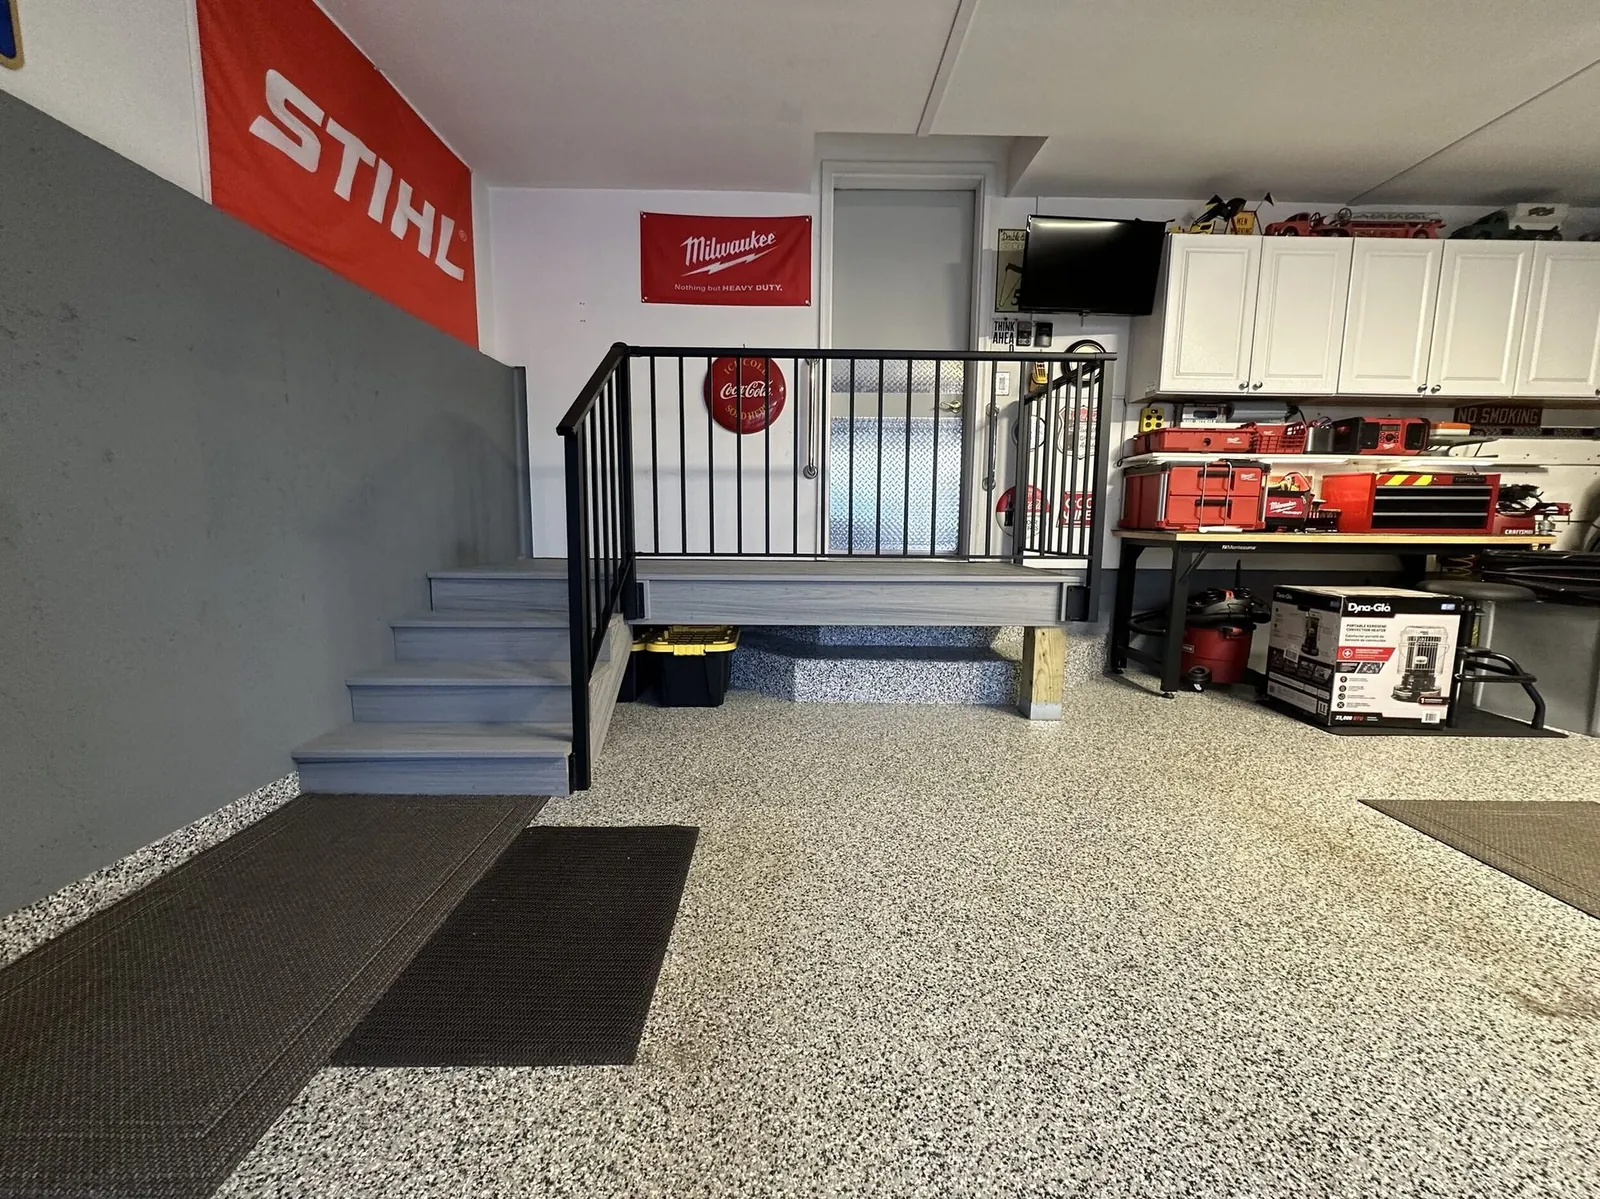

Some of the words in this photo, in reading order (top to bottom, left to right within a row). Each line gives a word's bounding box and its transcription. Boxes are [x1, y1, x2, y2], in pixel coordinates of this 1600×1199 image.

[249, 68, 465, 282] STIHL
[680, 230, 777, 266] Milwaukee
[674, 284, 706, 293] Nothing
[755, 284, 783, 292] DUTY.
[994, 321, 1015, 331] THINK
[725, 404, 747, 420] SOD
[748, 404, 767, 420] HER
[1458, 407, 1477, 423] NO
[1481, 408, 1540, 424] SMOKING
